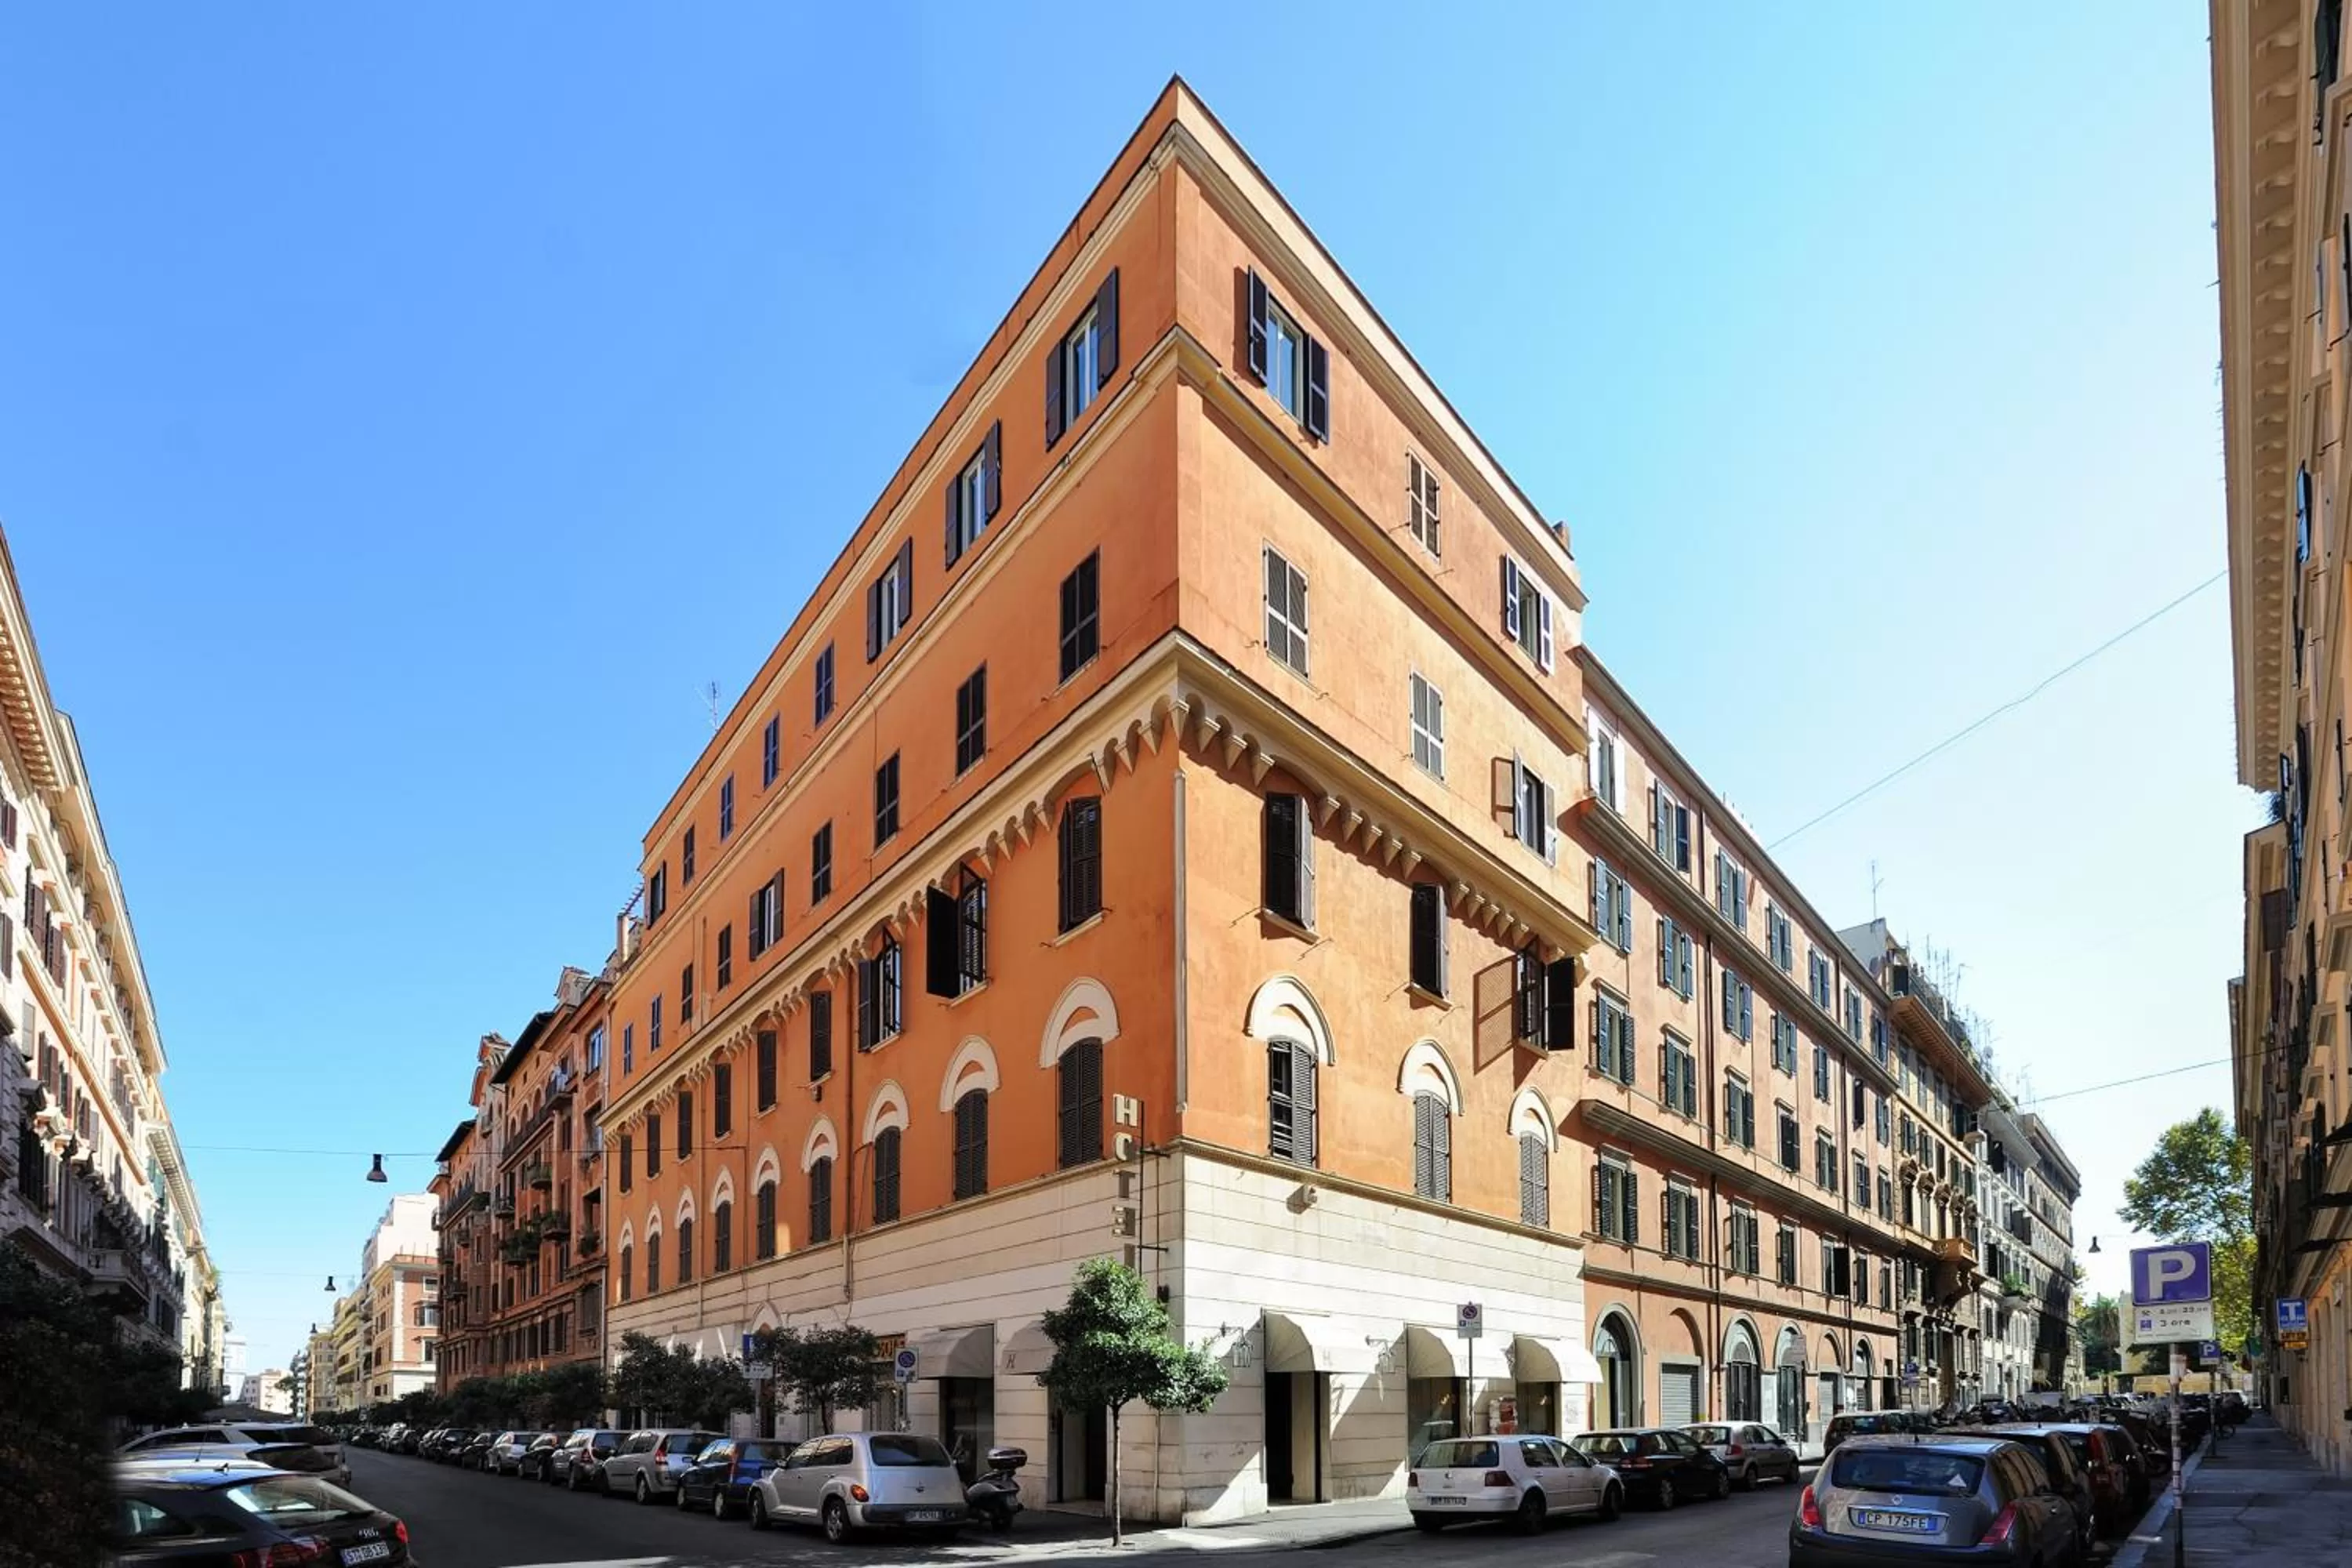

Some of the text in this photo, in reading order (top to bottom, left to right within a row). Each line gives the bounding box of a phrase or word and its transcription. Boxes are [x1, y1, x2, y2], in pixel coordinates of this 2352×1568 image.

[2147, 1250, 2196, 1299] P
[2282, 1302, 2302, 1321] T
[2204, 1345, 2215, 1356] P
